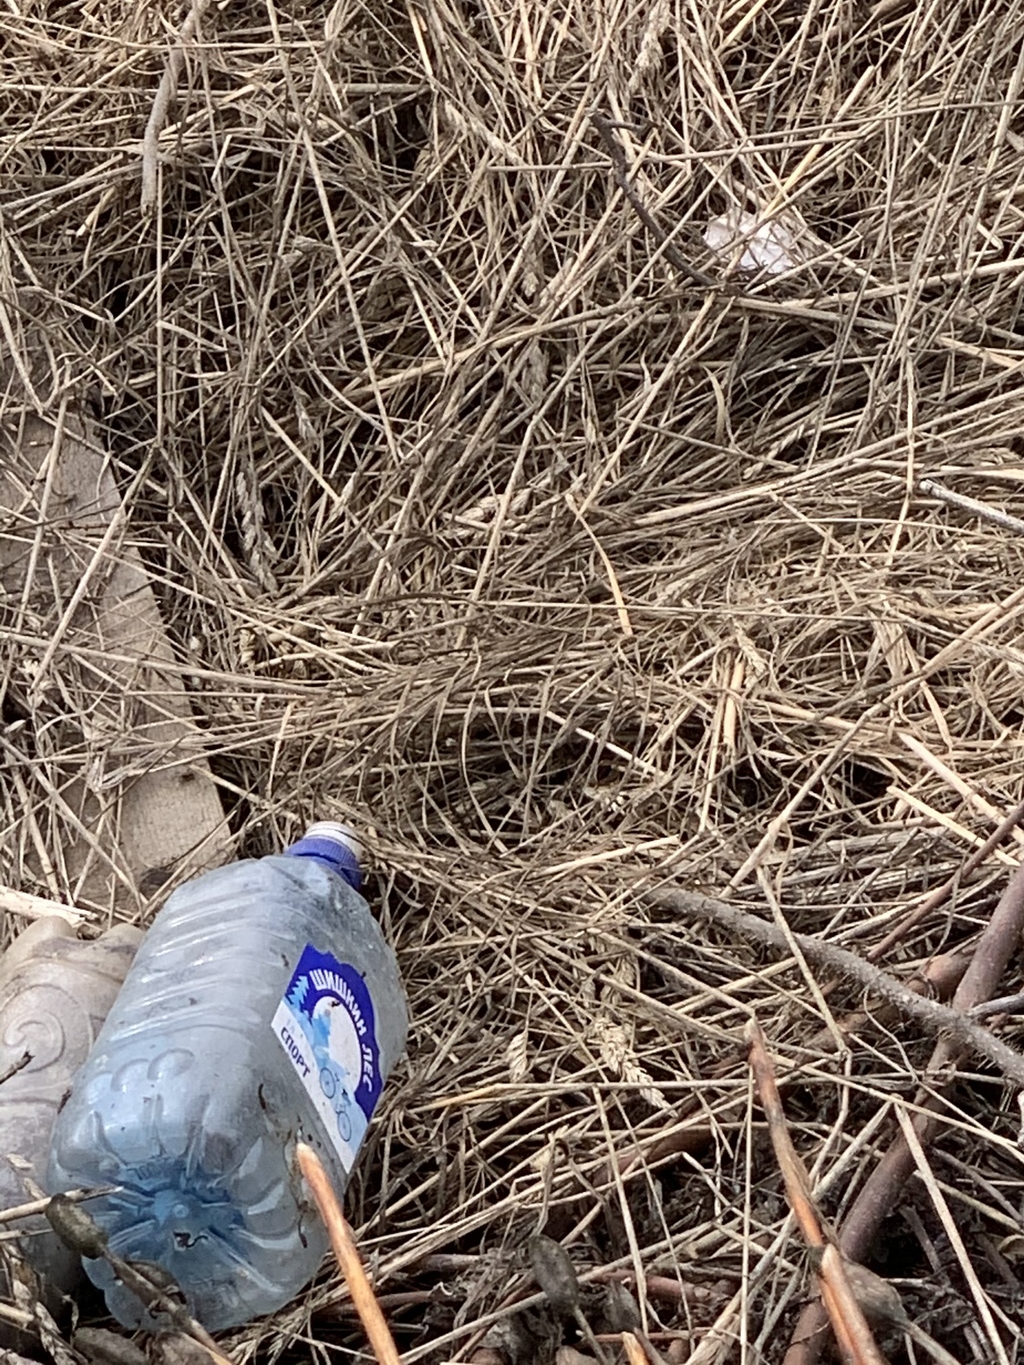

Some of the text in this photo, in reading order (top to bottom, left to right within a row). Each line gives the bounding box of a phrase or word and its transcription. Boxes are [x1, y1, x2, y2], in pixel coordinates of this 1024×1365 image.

[281, 1026, 310, 1077] СПОРТ
[309, 968, 374, 1092] ШИШКИН ЛЕС
